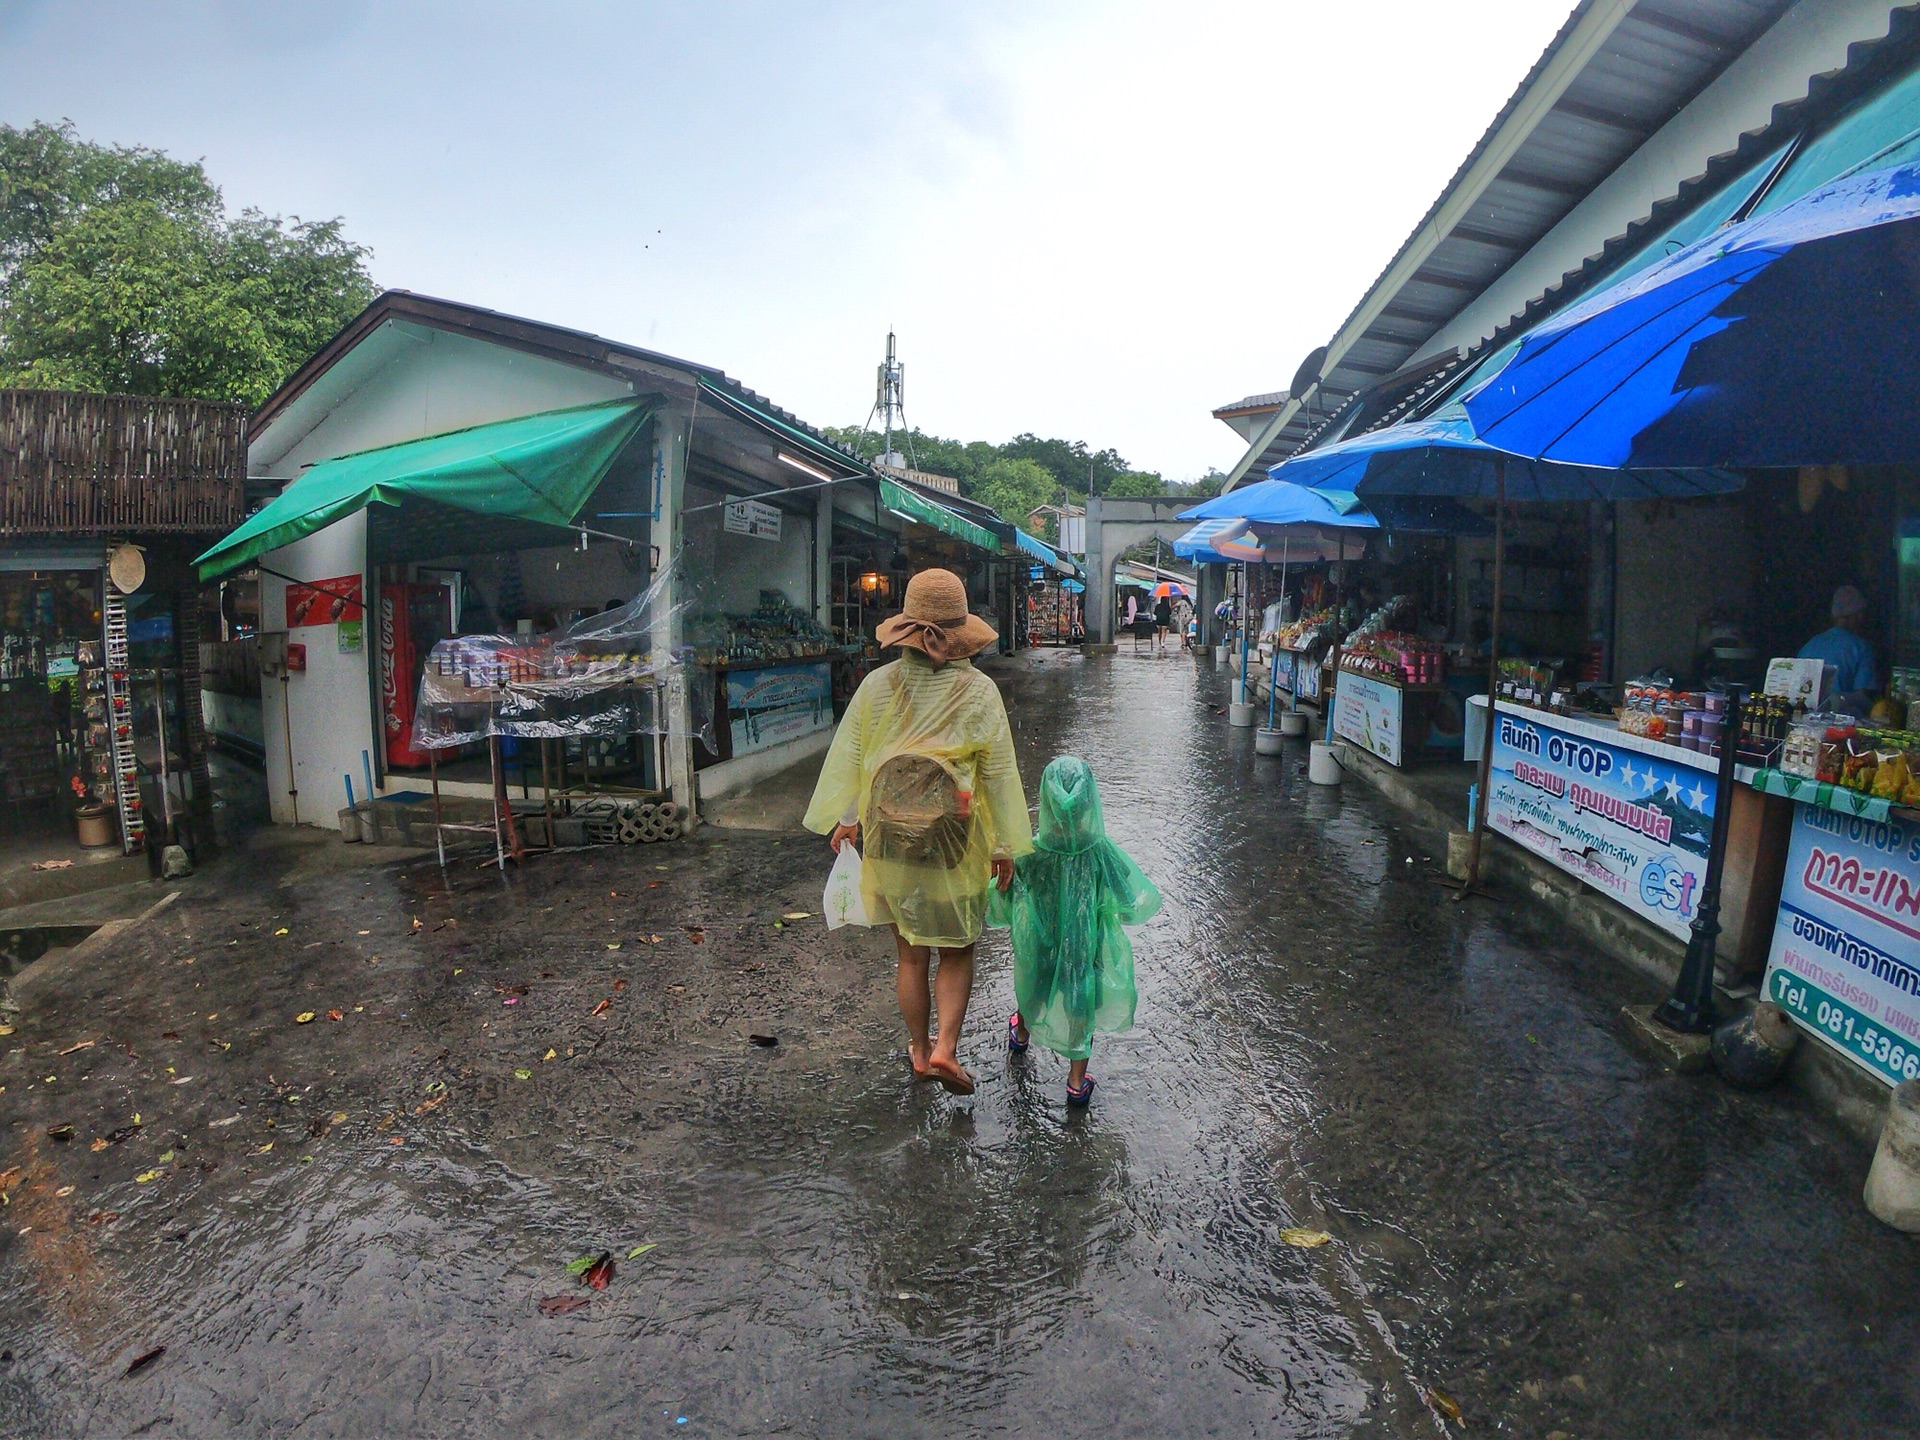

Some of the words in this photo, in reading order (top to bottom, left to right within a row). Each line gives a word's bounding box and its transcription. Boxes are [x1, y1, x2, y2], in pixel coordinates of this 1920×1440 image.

[1501, 719, 1540, 756] สินค้า
[1548, 737, 1613, 777] OTOP
[1514, 761, 1563, 795] กาละแม
[1849, 818, 1902, 854] OTOP
[1639, 861, 1697, 918] est
[1783, 949, 1879, 1014] ผ่านการรับรอง
[1778, 975, 1808, 1015] Tel.
[1816, 1001, 1920, 1080] 081-5366
